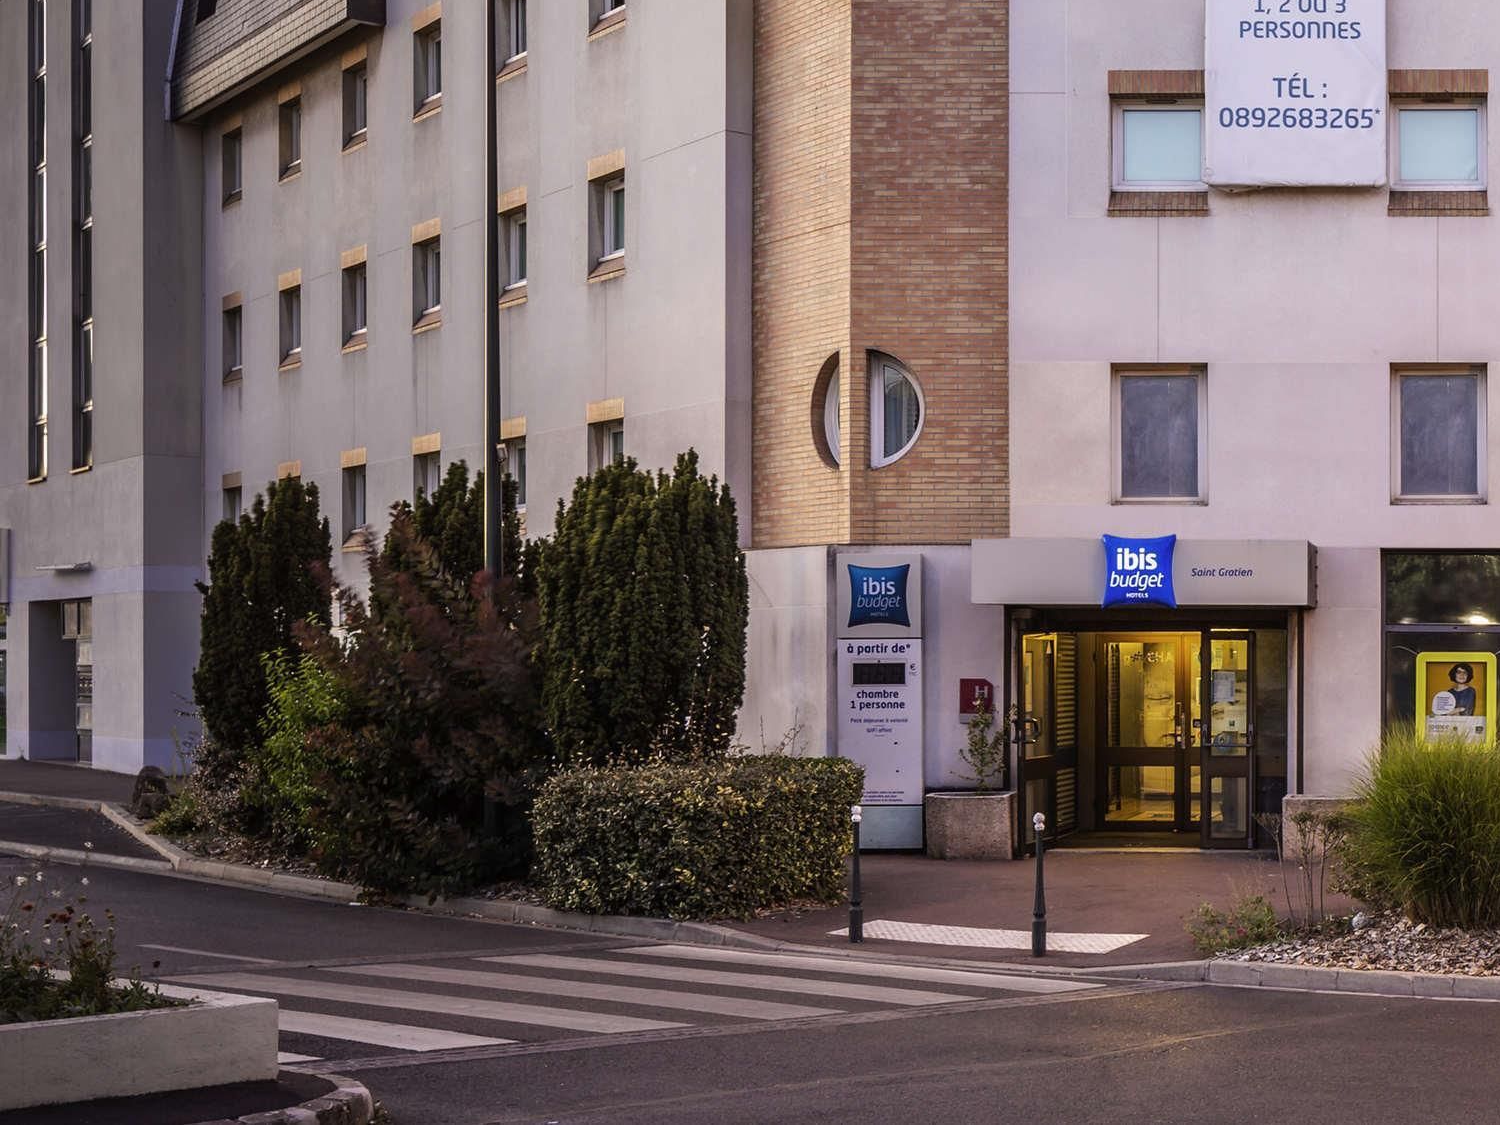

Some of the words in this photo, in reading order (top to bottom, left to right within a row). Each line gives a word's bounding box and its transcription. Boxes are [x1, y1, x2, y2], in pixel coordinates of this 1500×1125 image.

[1239, 21, 1361, 39] PERSONNES
[1116, 548, 1158, 570] ibis
[1191, 567, 1215, 577] Saint
[1218, 567, 1253, 577] Gratien
[863, 577, 896, 595] ibis
[1110, 571, 1164, 591] budget
[857, 594, 901, 611] budget
[847, 643, 854, 653] à
[857, 643, 888, 655] partir
[856, 690, 899, 699] chambre
[850, 701, 856, 709] 1
[859, 701, 905, 711] personne
